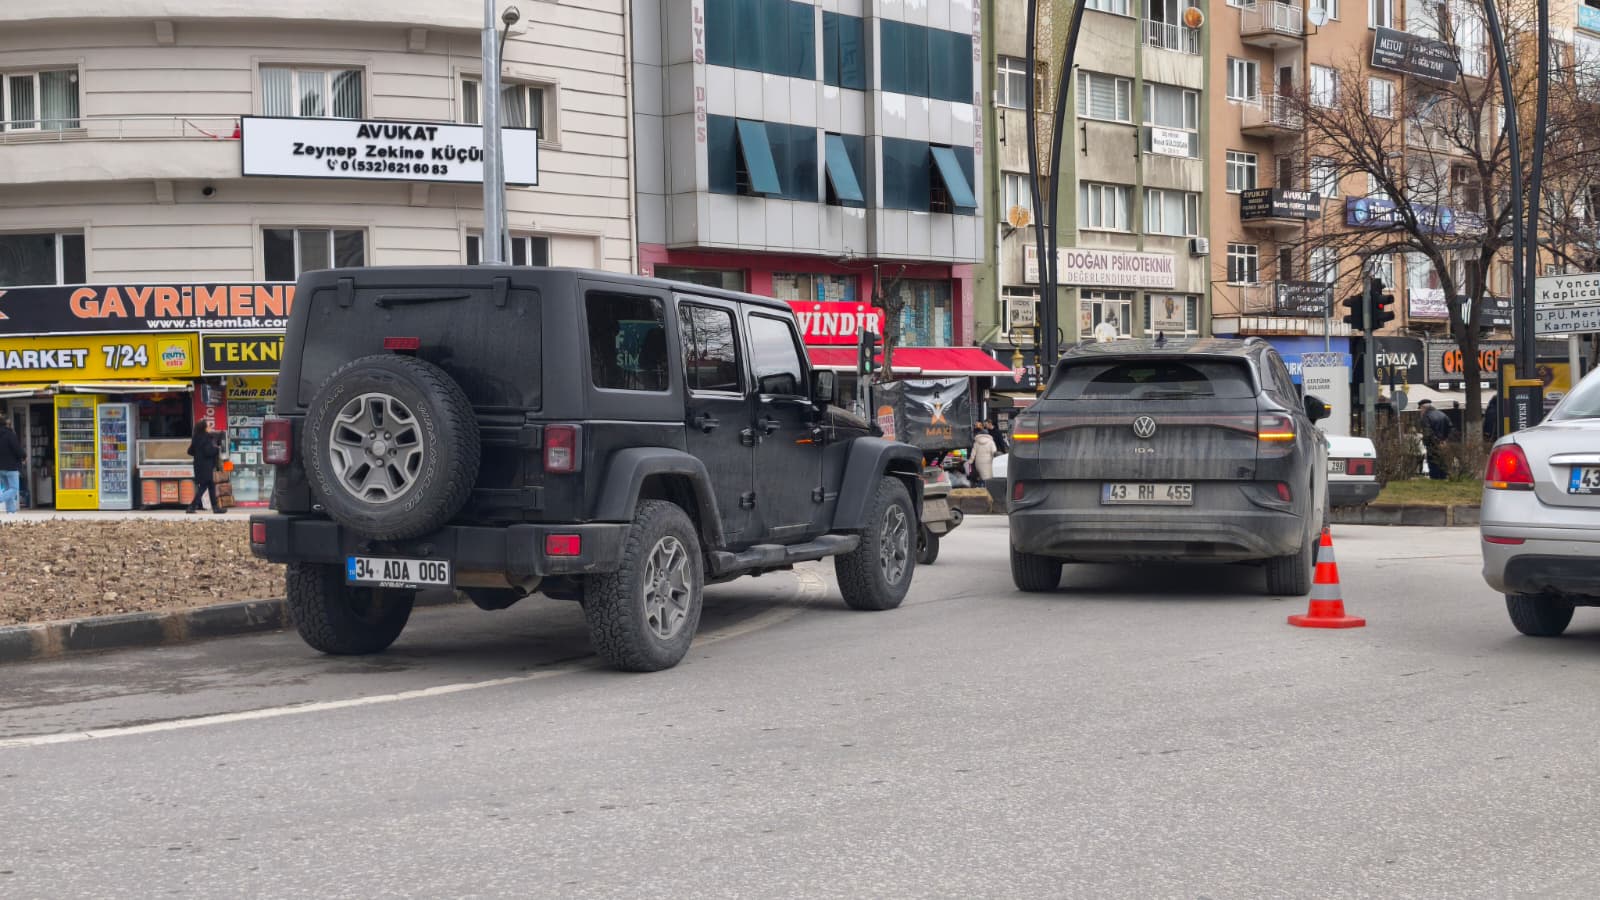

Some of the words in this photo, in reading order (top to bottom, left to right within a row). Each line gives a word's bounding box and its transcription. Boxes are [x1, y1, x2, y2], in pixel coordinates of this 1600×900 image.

[356, 122, 438, 141] AVUKAT
[292, 142, 357, 159] Zeynep
[365, 144, 425, 160] Zekine
[340, 160, 349, 171] 0
[413, 162, 429, 174] 60
[431, 163, 448, 175] 83
[1282, 191, 1312, 201] AVUKAT
[1067, 251, 1107, 269] DOĞAN
[1112, 252, 1172, 273] PSİKOTEKNİK
[1067, 270, 1137, 286] DEĞERLENDİRME
[1556, 279, 1600, 289] Yonca
[1542, 288, 1600, 301] Kaplıca
[1544, 319, 1600, 331] Kampüs
[0, 349, 87, 369] ARKET
[102, 344, 148, 370] 7/24
[1582, 468, 1600, 487] 43
[1111, 485, 1127, 499] 43
[1138, 485, 1155, 500] RH
[1167, 485, 1191, 500] 455
[356, 559, 374, 578] 34
[383, 560, 410, 580] ADA
[419, 562, 447, 581] 006
